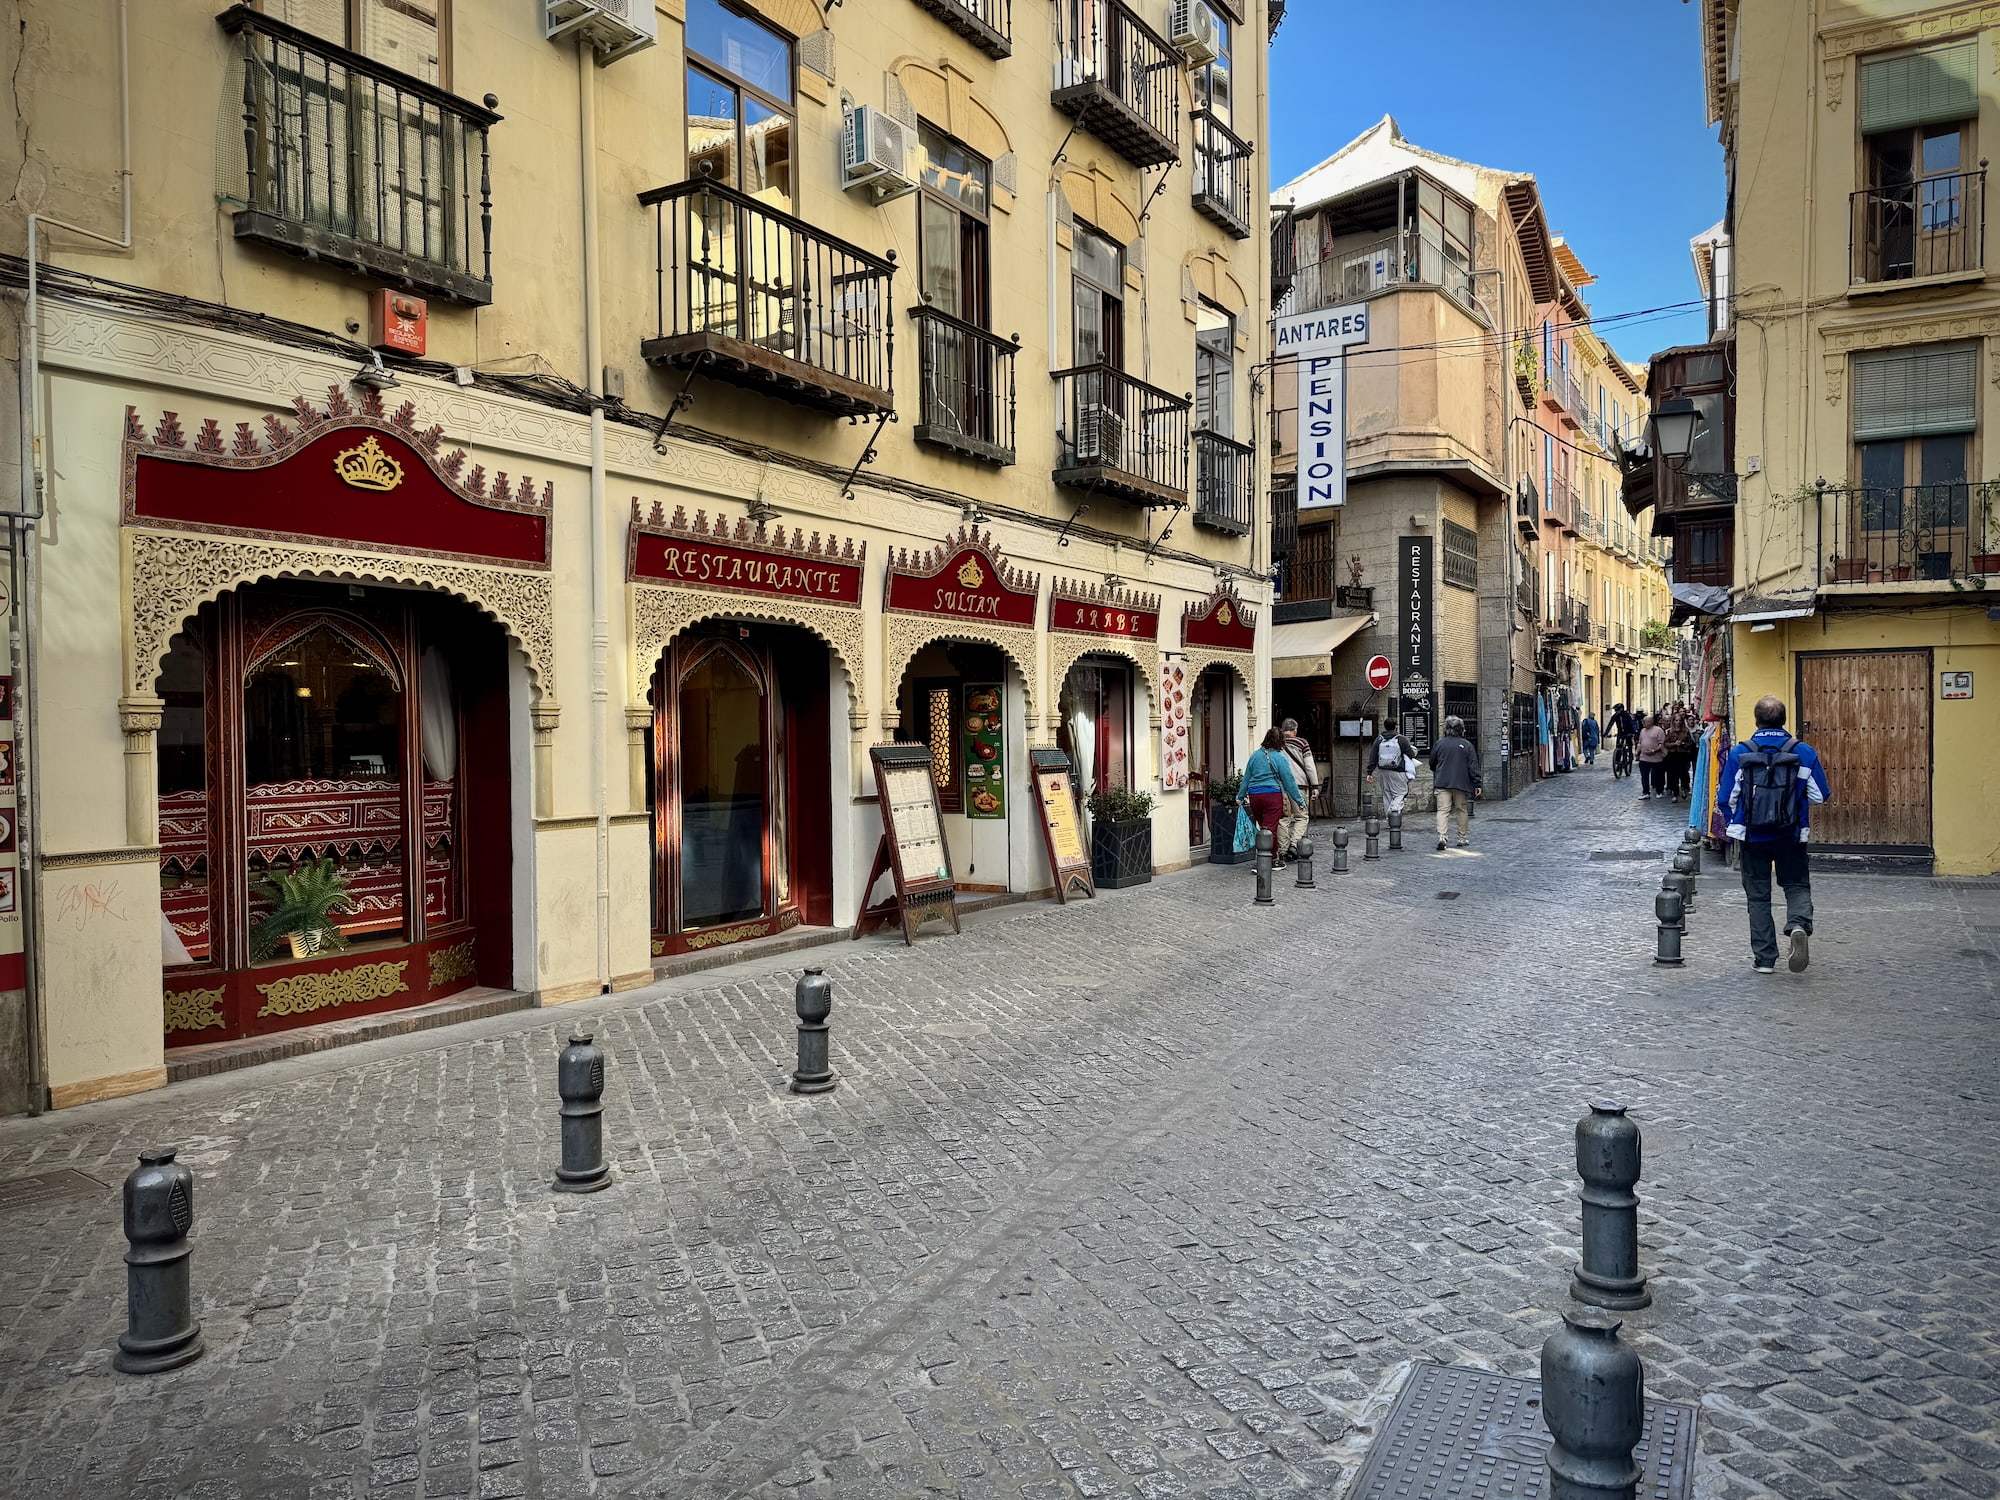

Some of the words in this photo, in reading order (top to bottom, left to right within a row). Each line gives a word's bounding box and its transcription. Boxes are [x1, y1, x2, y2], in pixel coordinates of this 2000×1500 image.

[1278, 314, 1365, 346] ANTARES
[1307, 357, 1334, 502] PENSION
[663, 547, 841, 594] RESTAURANTE
[934, 588, 1000, 617] SULTAN
[1410, 545, 1421, 666] RESTAURANTE
[1075, 608, 1140, 633] ARABE
[1402, 687, 1430, 695] BODEGA
